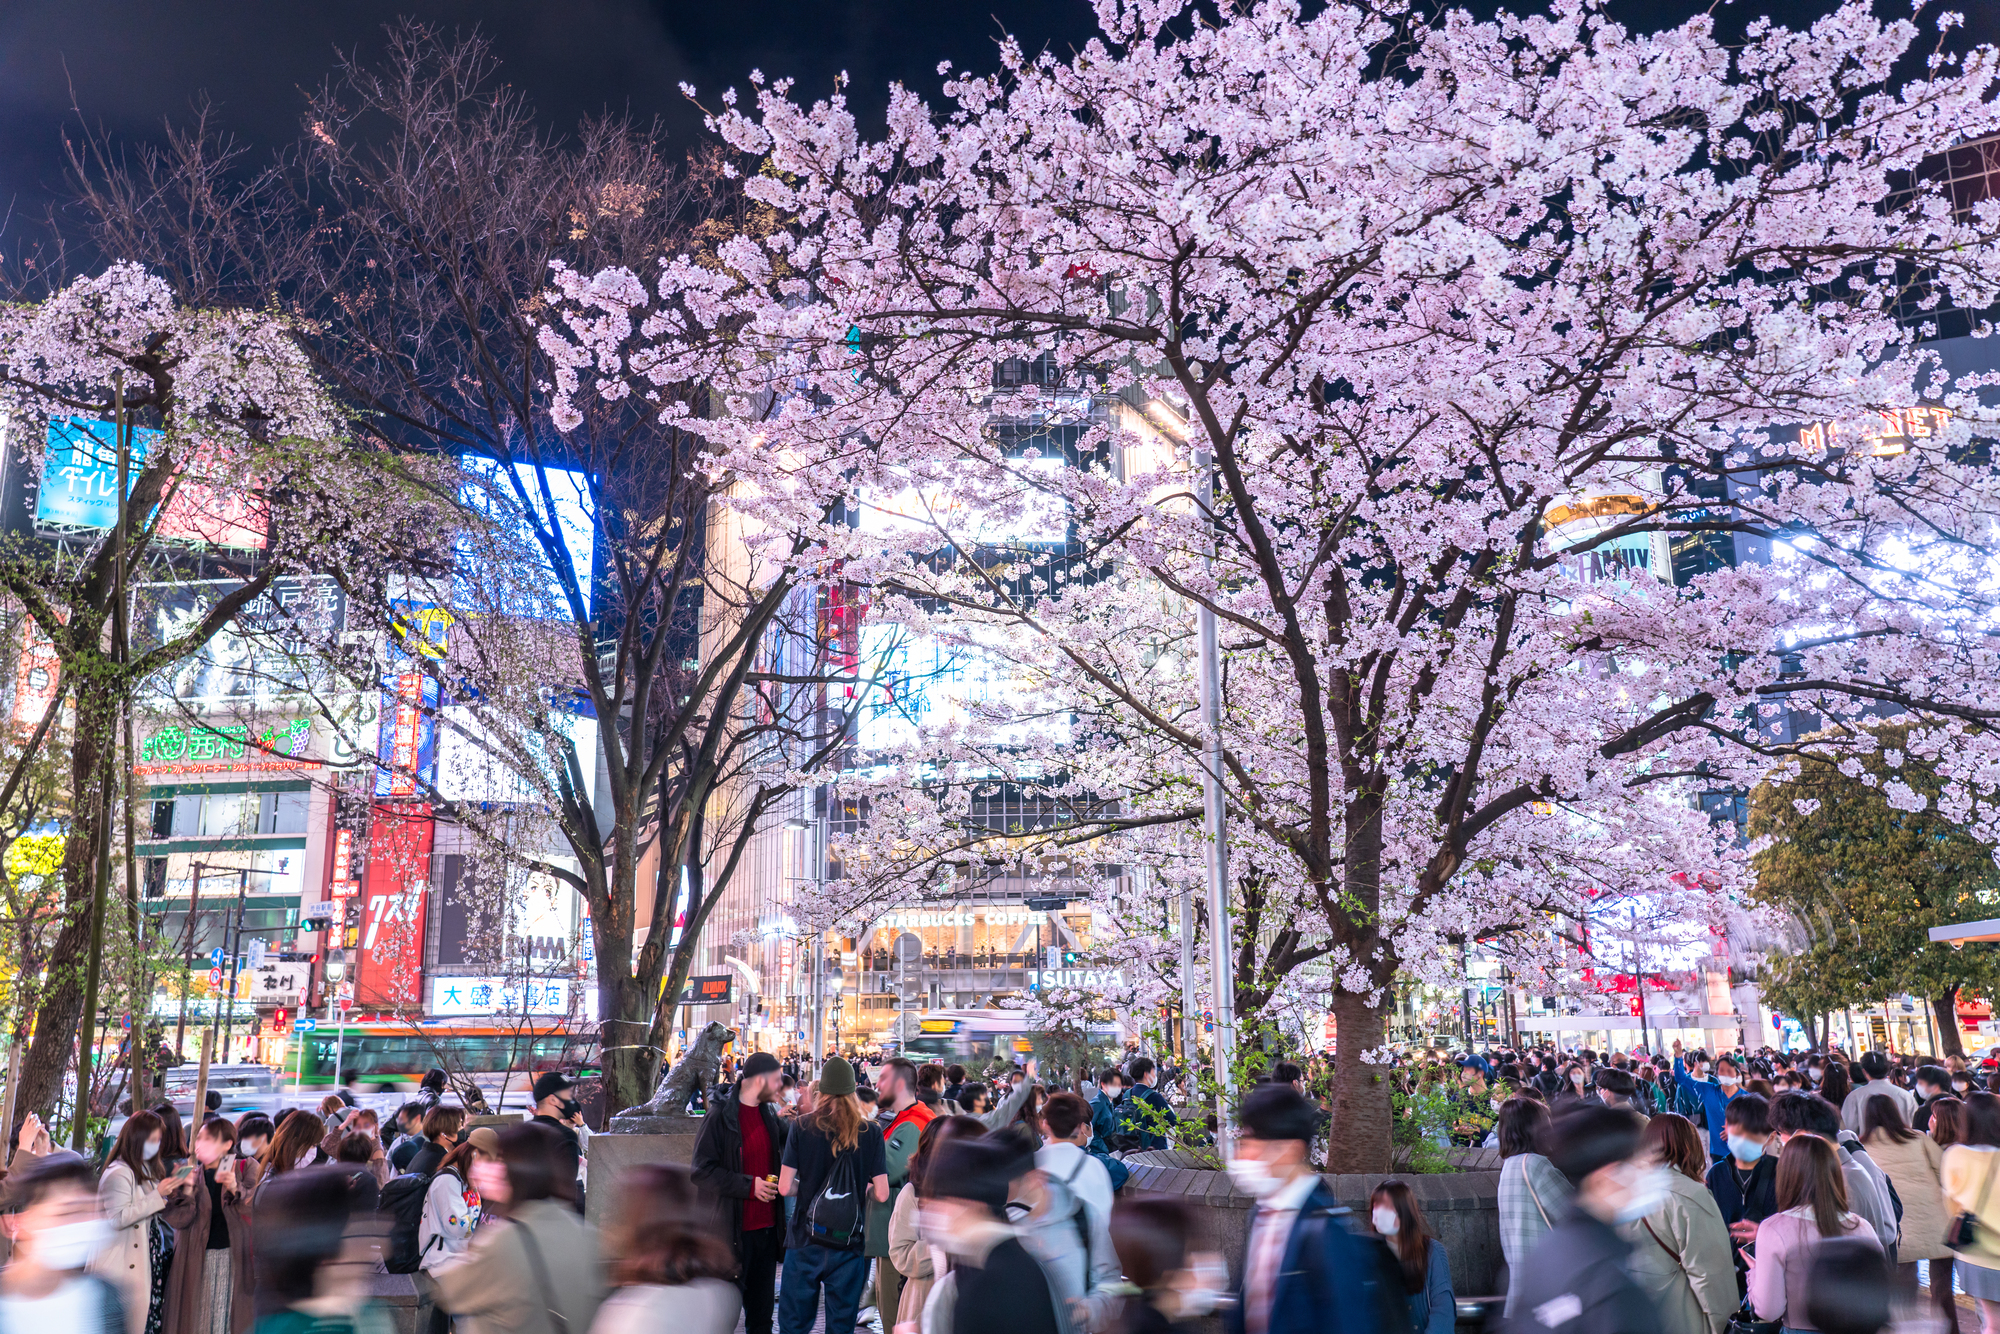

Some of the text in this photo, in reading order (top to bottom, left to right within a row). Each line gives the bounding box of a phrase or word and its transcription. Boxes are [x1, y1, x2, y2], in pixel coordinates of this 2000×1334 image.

[188, 735, 245, 760] 西村
[364, 880, 424, 949] クスリ
[877, 912, 1048, 929] STARBUCKS COFFEE
[1028, 970, 1124, 988] TSUTAYA
